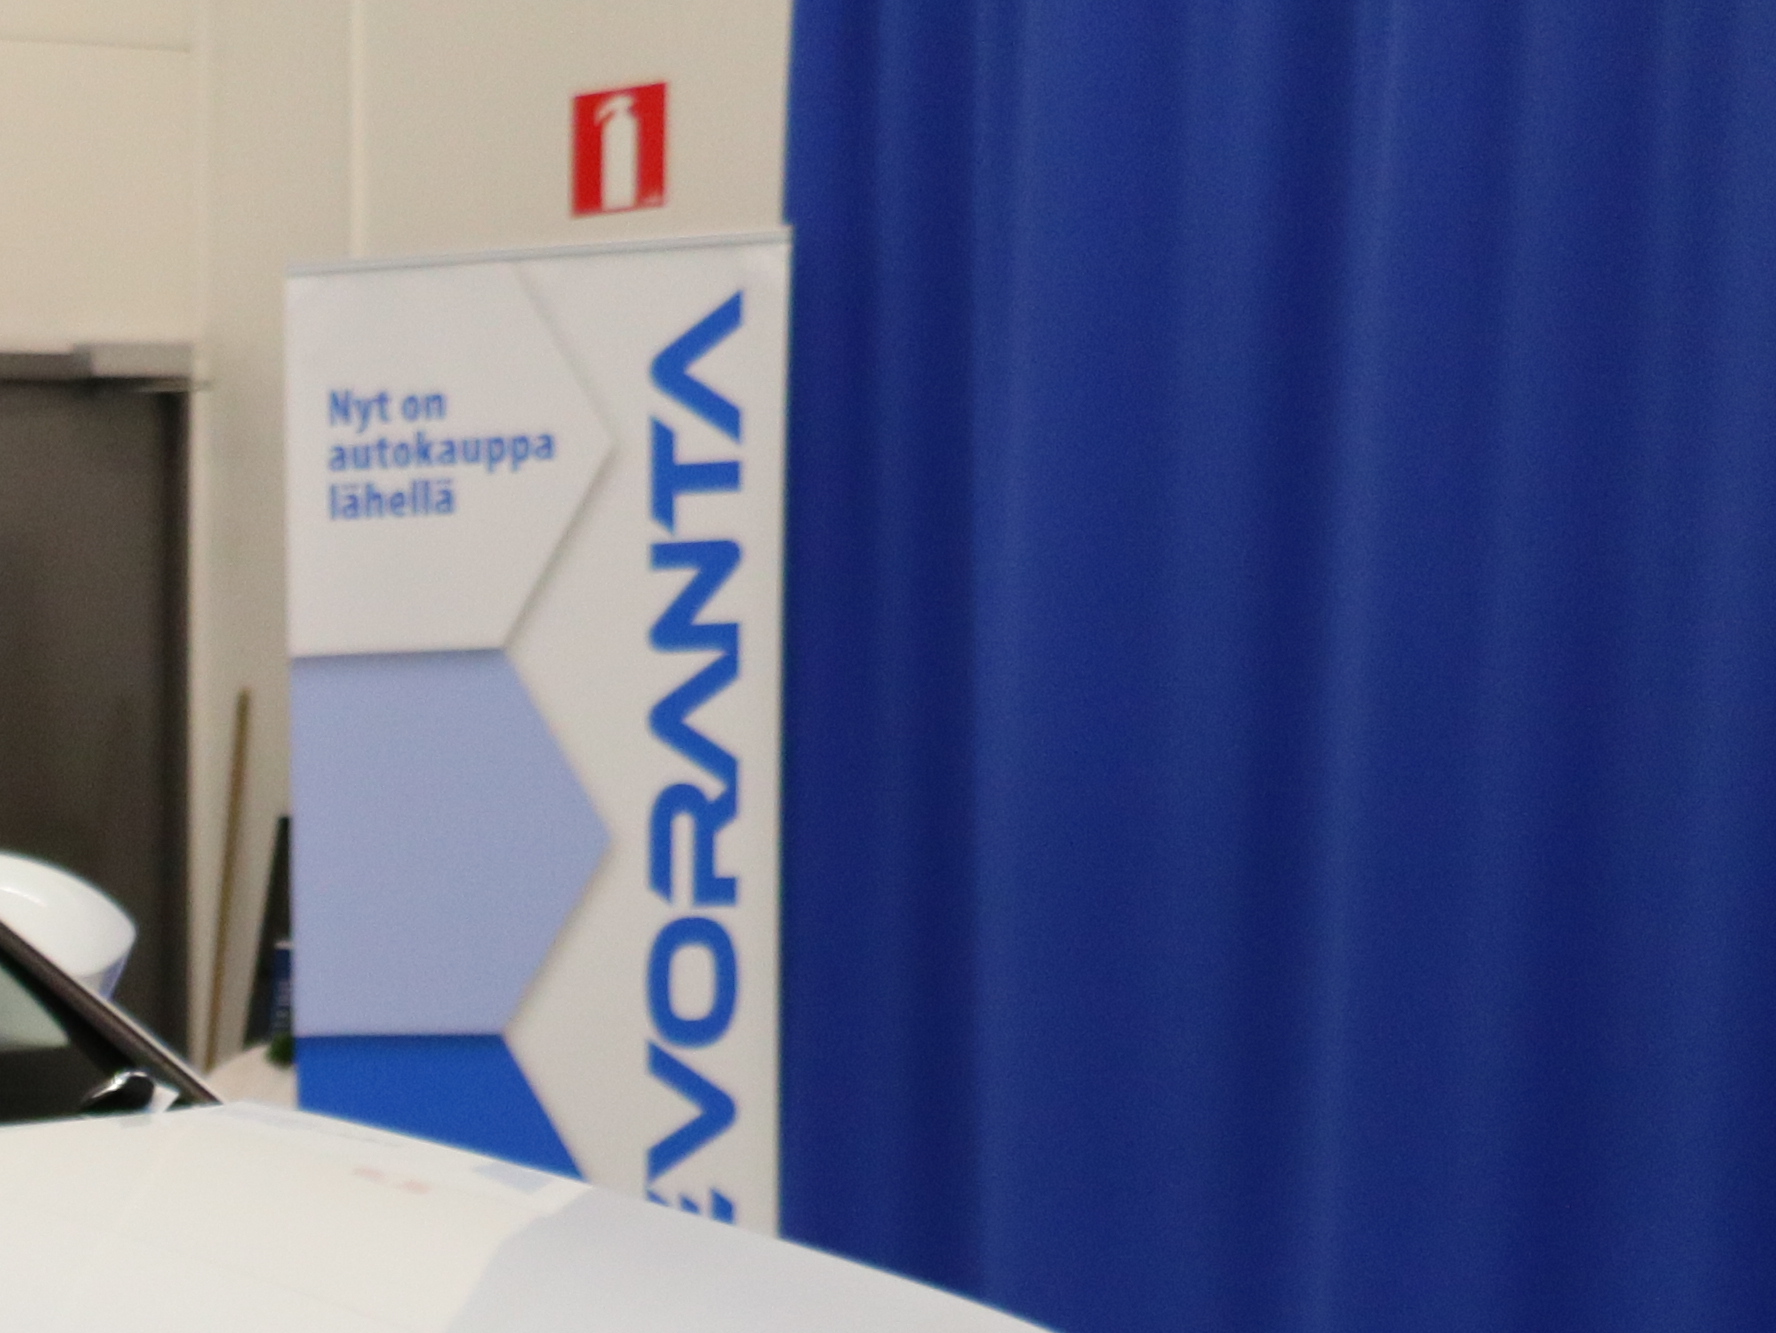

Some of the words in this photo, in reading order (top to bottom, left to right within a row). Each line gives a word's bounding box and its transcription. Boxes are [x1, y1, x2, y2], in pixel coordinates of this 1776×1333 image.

[329, 390, 389, 433] Nyt
[402, 394, 447, 421] on
[329, 431, 556, 473] autokauppa
[329, 479, 455, 520] lähellä
